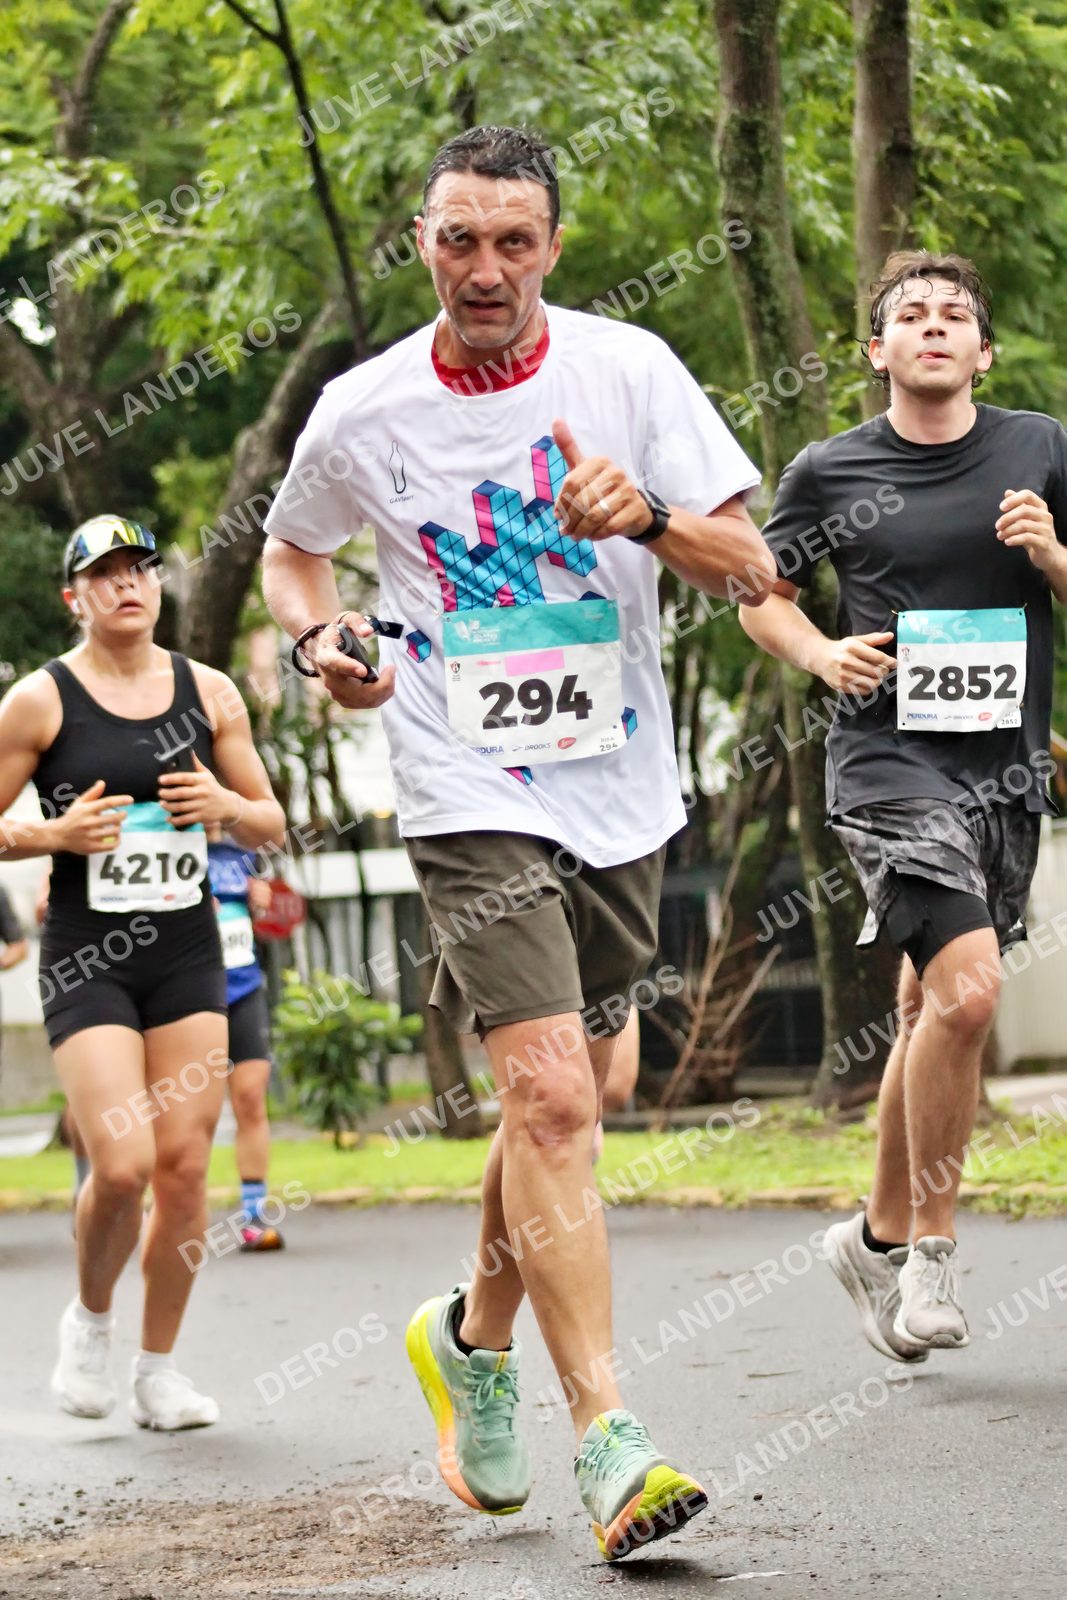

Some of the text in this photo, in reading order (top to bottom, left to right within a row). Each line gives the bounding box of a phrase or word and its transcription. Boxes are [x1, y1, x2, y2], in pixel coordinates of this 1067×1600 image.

[908, 664, 1017, 701] 2852
[479, 675, 592, 729] 294
[600, 743, 618, 752] 294
[100, 853, 199, 885] 4210
